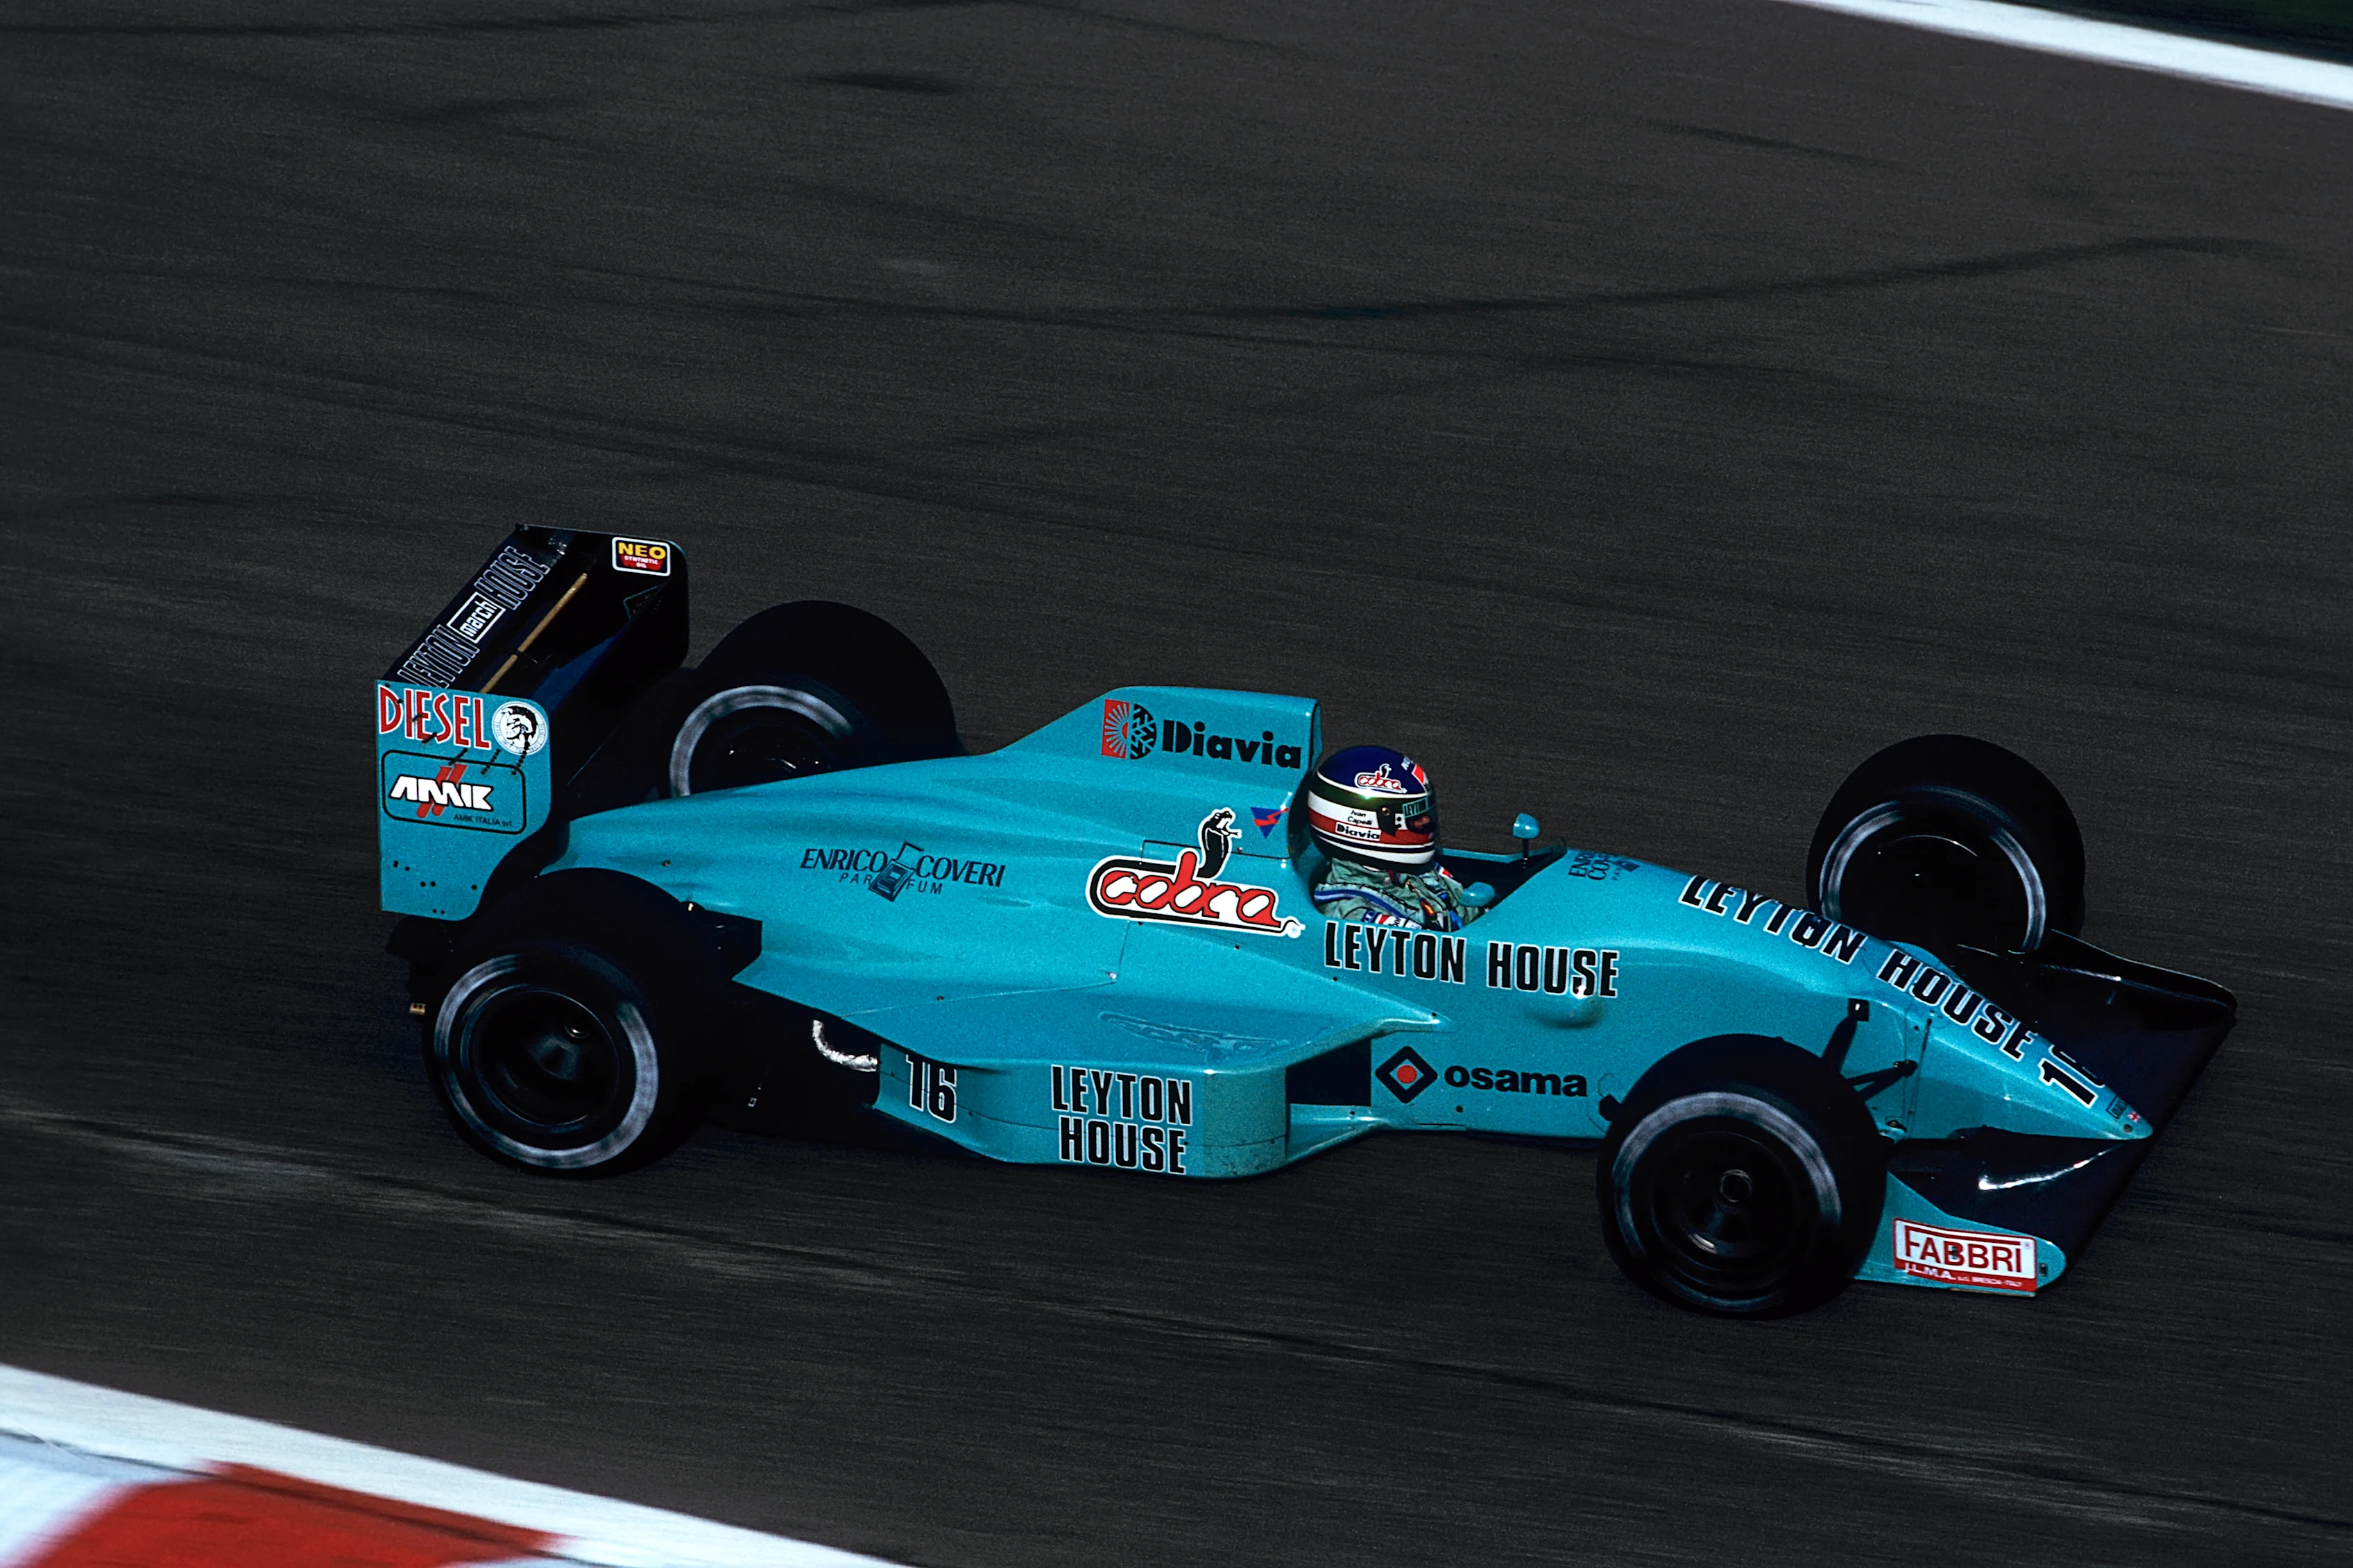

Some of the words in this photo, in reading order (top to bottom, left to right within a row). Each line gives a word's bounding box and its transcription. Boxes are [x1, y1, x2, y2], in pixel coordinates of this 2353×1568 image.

[618, 542, 666, 560] NEO
[474, 546, 550, 610] HOUSE
[459, 599, 497, 637] march
[378, 684, 491, 750] DIESEL
[1163, 719, 1301, 769] Diavia
[1359, 772, 1402, 791] cobra
[475, 816, 499, 825] ITALIA
[1337, 824, 1380, 839] Diavia
[800, 849, 888, 872] ENRICO
[916, 855, 1005, 887] COVERI
[1100, 851, 1282, 929] cobra
[1324, 920, 1467, 985] LEYTON
[1486, 941, 1620, 999] HOUSE
[1678, 875, 1868, 965] LEYTON
[1876, 948, 2038, 1062] HOUSE
[906, 1053, 957, 1123] 16
[1051, 1064, 1192, 1126] LEYTON
[1444, 1065, 1587, 1097] osama
[1059, 1114, 1186, 1175] HOUSE
[1904, 1225, 2021, 1273] FABBRI
